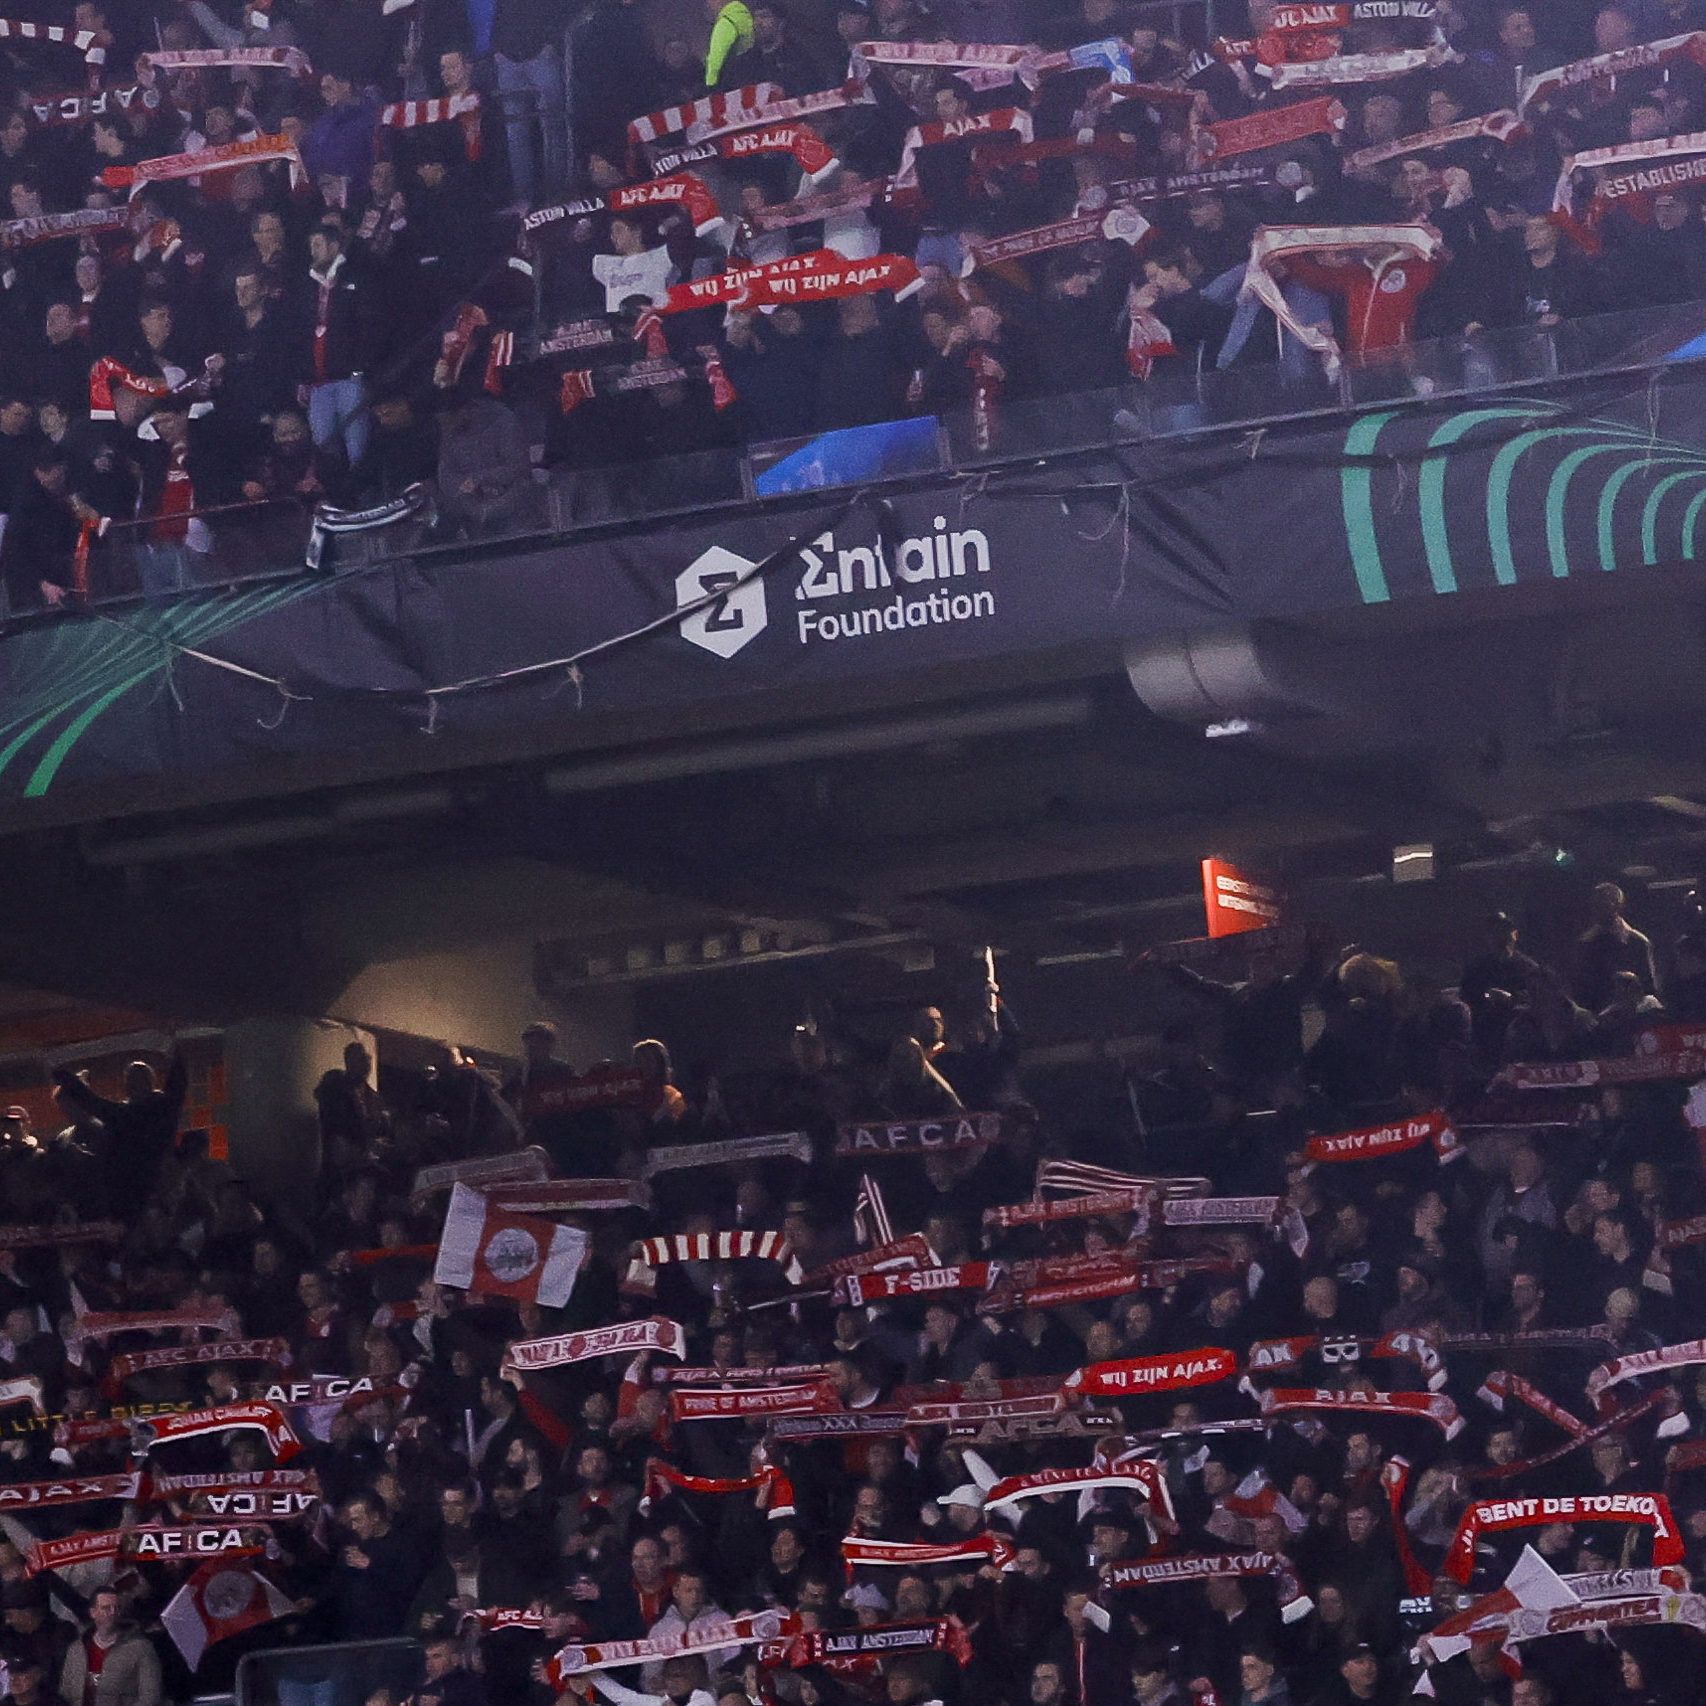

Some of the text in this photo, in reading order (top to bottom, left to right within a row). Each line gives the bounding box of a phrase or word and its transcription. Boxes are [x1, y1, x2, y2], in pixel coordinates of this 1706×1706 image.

[944, 114, 990, 137] AJAX
[844, 266, 890, 287] AJAX
[798, 588, 996, 643] Foundation
[885, 1267, 960, 1295] F-SIDE
[197, 1344, 255, 1361] AJAX
[1100, 1371, 1127, 1388] WIJ
[1132, 1366, 1170, 1384] ZIJN
[1476, 1502, 1534, 1523] BENT
[1542, 1499, 1574, 1515] DE
[1116, 1553, 1275, 1582] AJAX AMSTERDAM
[861, 1631, 934, 1649] AMSTERDAM
